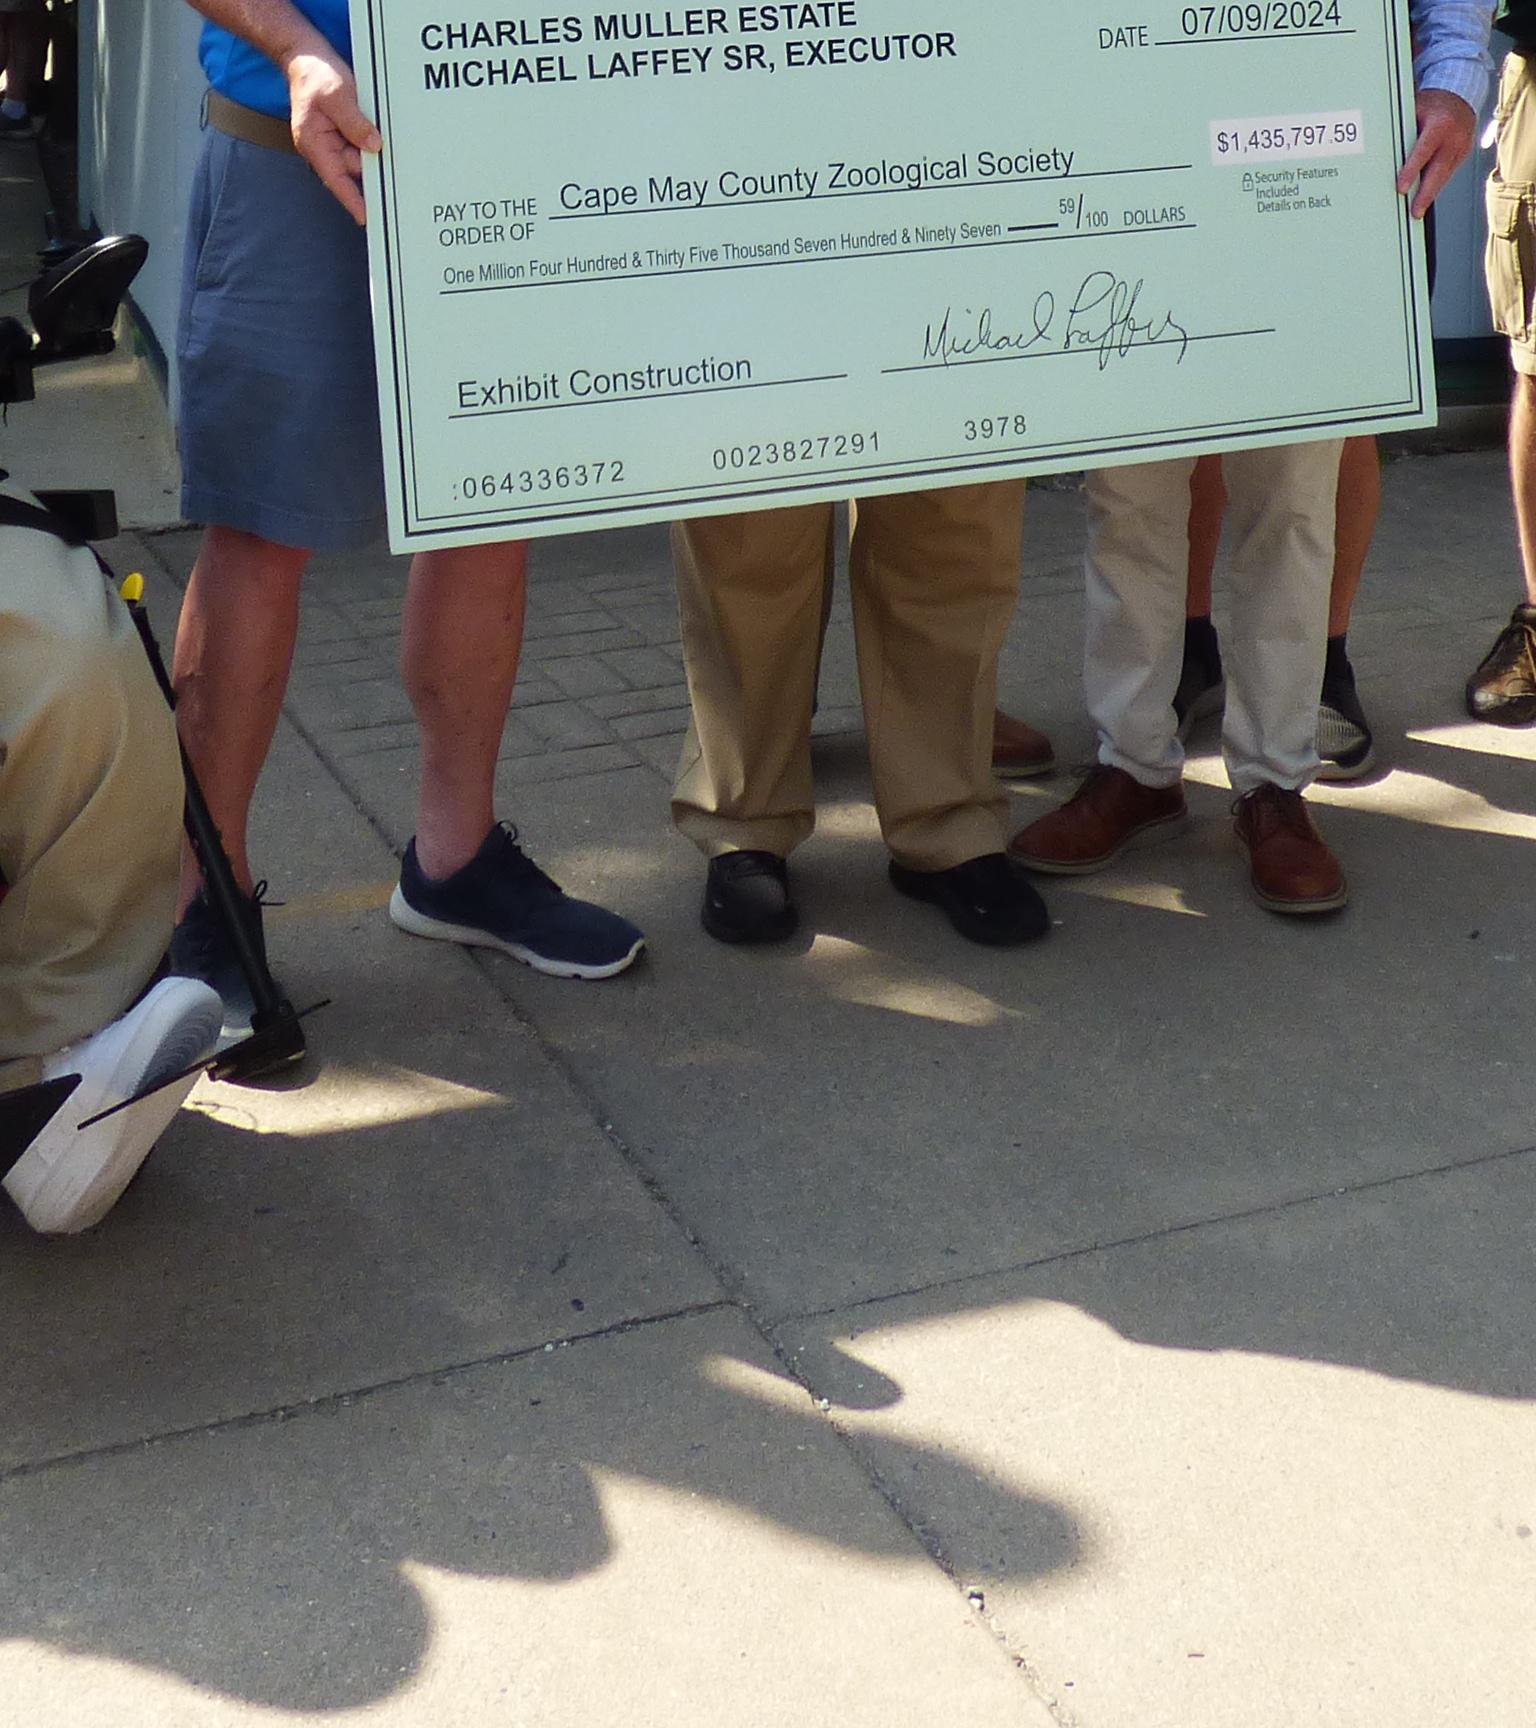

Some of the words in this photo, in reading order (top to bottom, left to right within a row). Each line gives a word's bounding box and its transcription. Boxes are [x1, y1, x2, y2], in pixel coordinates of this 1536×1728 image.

[420, 16, 584, 51] CHARLES
[593, 8, 728, 41] MULLER
[738, 0, 857, 33] ESTATE
[1099, 26, 1149, 49] DATE
[1181, 0, 1342, 36] 07/09/2024
[424, 56, 578, 90] MICHAEL
[587, 46, 712, 80] LAFFEY
[723, 43, 776, 74] SR,
[785, 32, 957, 68] EXECUTOR
[1216, 122, 1358, 154] $1,435,797.59
[559, 183, 639, 215] Cape
[648, 175, 709, 208] May
[718, 167, 818, 200] County
[828, 153, 968, 190] Zoological
[977, 147, 1075, 178] Society
[1254, 170, 1295, 184] Security
[1297, 166, 1339, 181] Features
[1256, 184, 1300, 199] Included
[433, 202, 467, 223] PAY
[470, 201, 499, 220] TO
[502, 198, 538, 218] THE
[1257, 200, 1292, 214] Details
[1293, 200, 1307, 209] on
[1308, 194, 1332, 209] Back
[439, 224, 505, 247] ORDER
[509, 222, 536, 242] OF
[443, 266, 475, 285] One
[479, 263, 526, 281] Million
[530, 259, 563, 277] Four
[567, 252, 628, 276] Hundred
[631, 251, 643, 269] &
[645, 248, 685, 270] Thirty
[689, 245, 719, 264] Five
[722, 239, 790, 262] Thousand
[794, 235, 837, 255] Seven
[840, 229, 898, 250] Hundred
[901, 226, 912, 244] &
[915, 222, 956, 244] Ninety
[960, 221, 1002, 240] Seven
[1123, 206, 1186, 227] DOLLARS
[457, 372, 561, 409] Exhibit
[569, 355, 753, 397] Construction
[712, 430, 881, 471] 0023827291
[964, 414, 1027, 442] 3978
